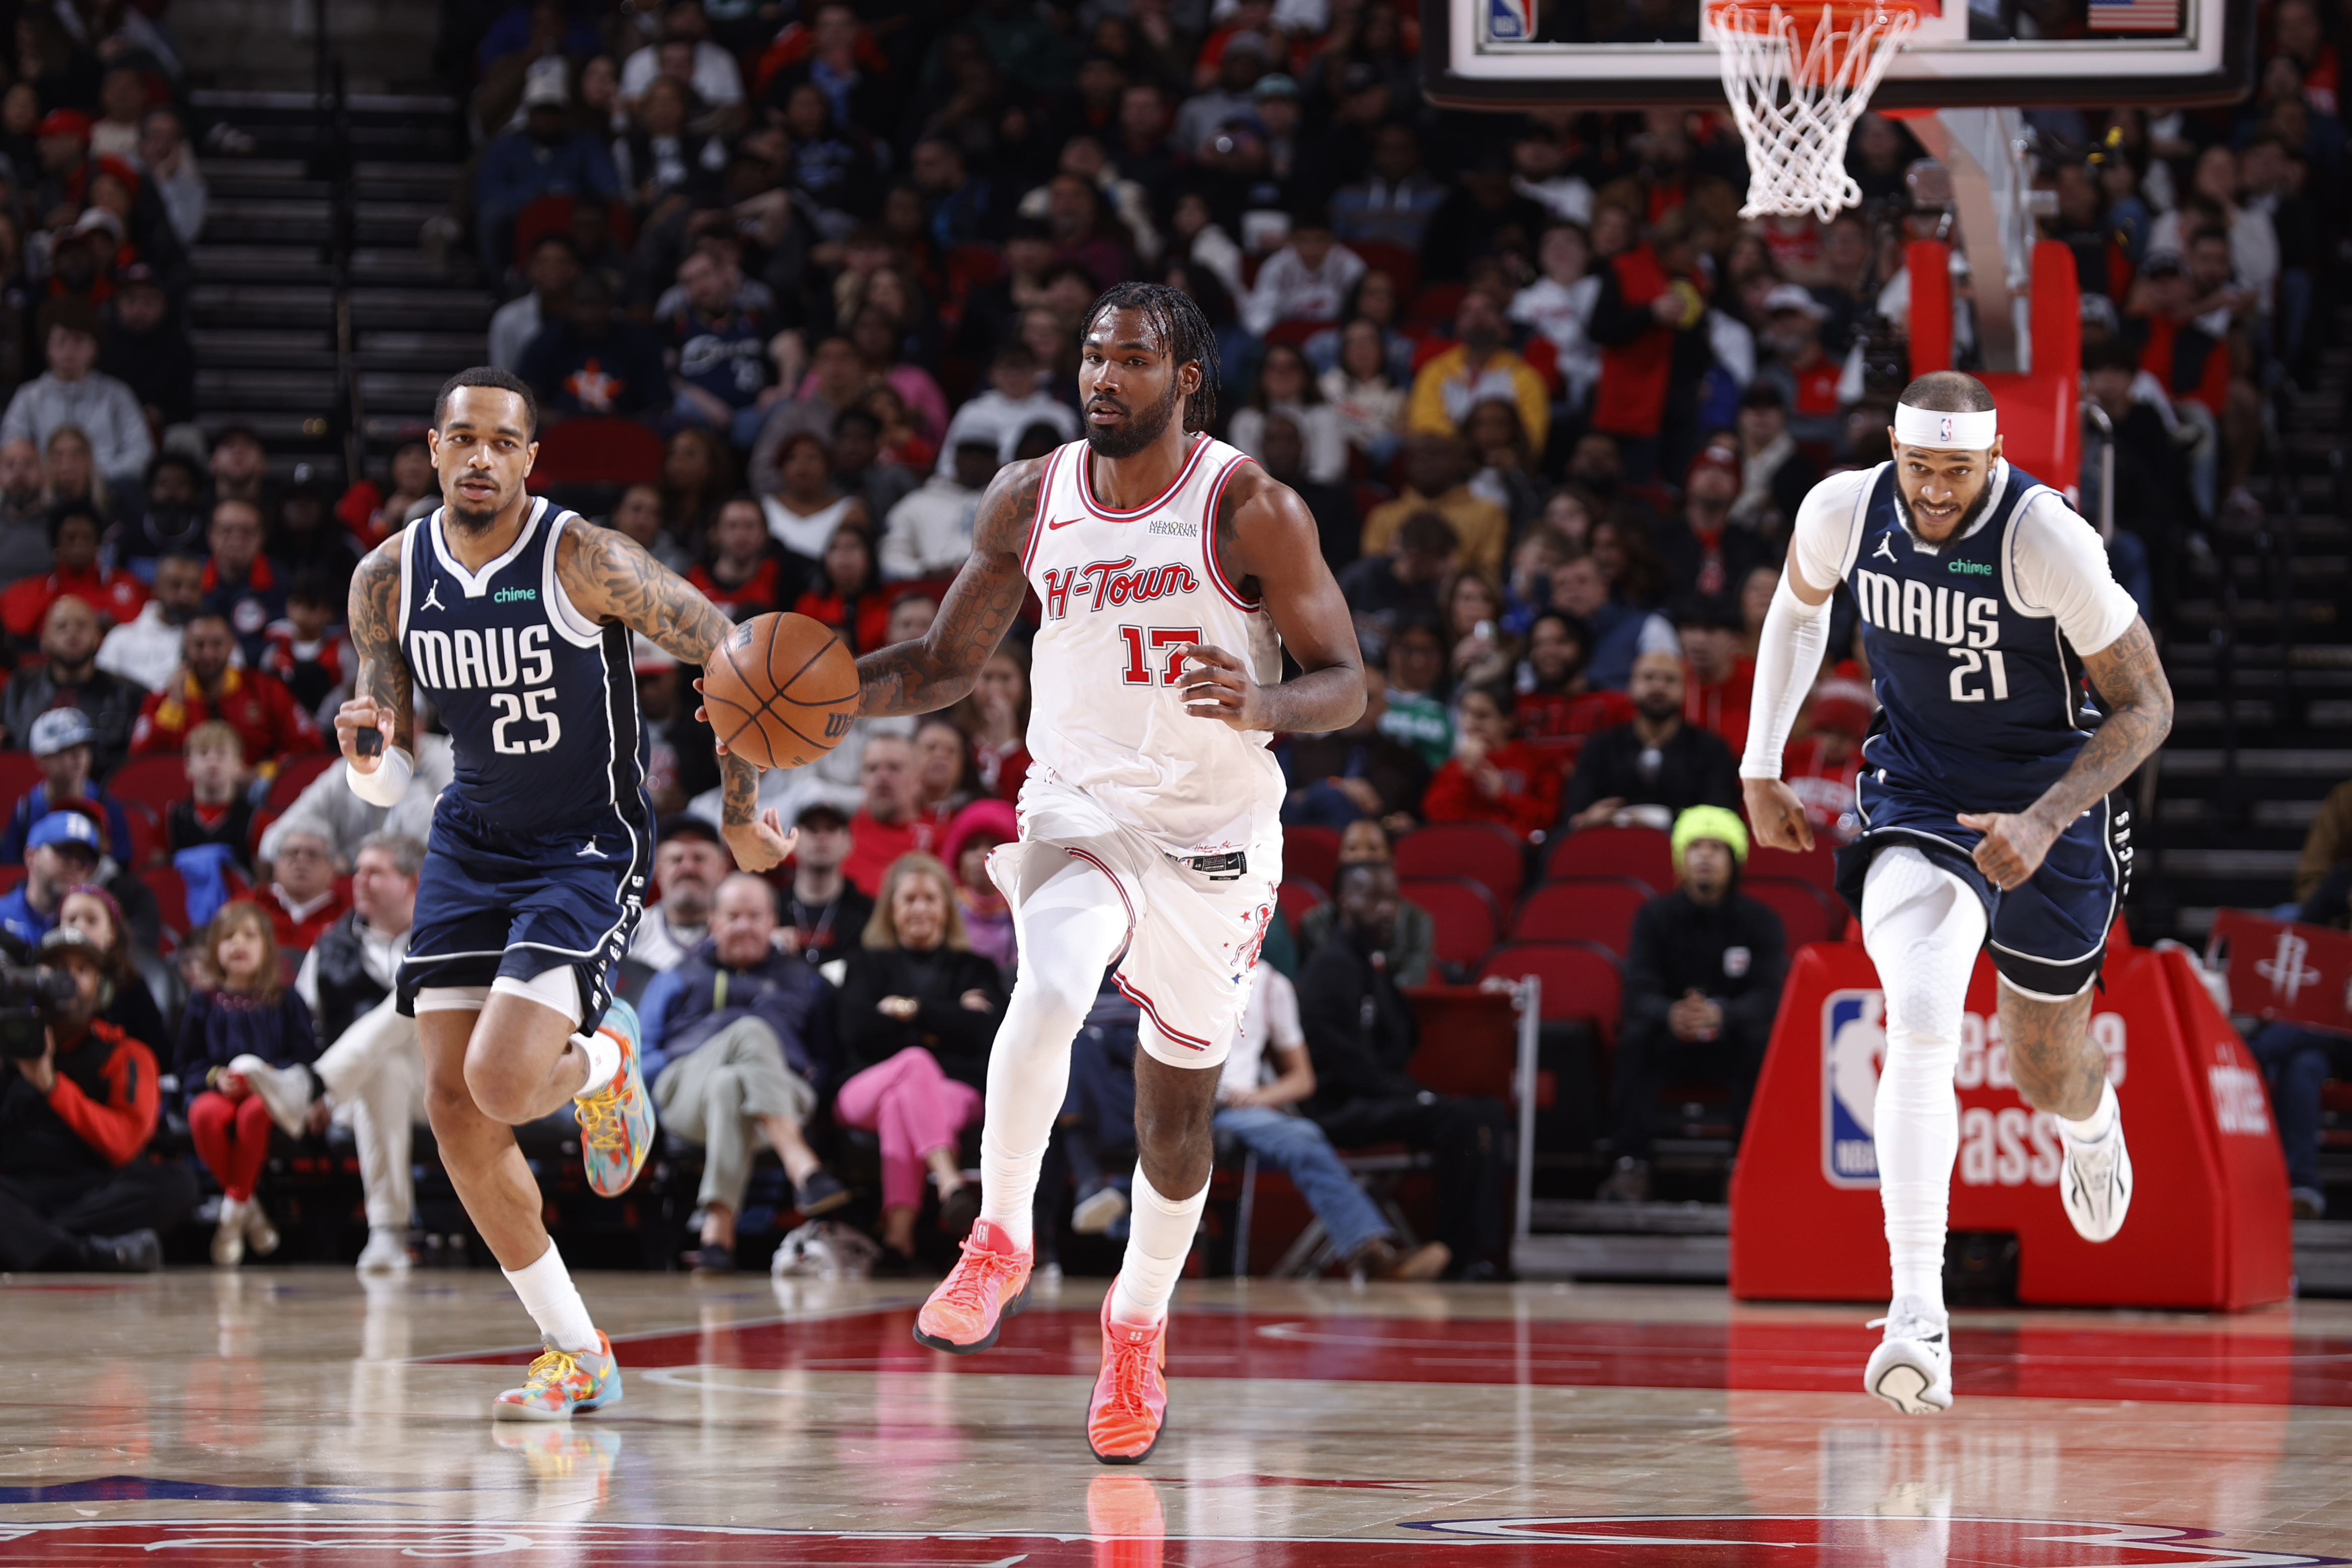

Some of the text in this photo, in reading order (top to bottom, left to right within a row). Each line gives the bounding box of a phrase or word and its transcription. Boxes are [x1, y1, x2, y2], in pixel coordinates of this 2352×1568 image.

[1149, 525, 1198, 537] HERMANN
[1150, 520, 1198, 531] MEMORIAL
[494, 587, 536, 604] chime
[1043, 555, 1199, 620] H-Town
[1948, 558, 1993, 576] chime
[1857, 568, 2000, 649] MAVS
[409, 623, 554, 690] MAVS
[1119, 624, 1202, 687] 17
[1948, 647, 2009, 702] 21
[490, 687, 561, 755] 25
[1958, 1102, 2063, 1187] ass
